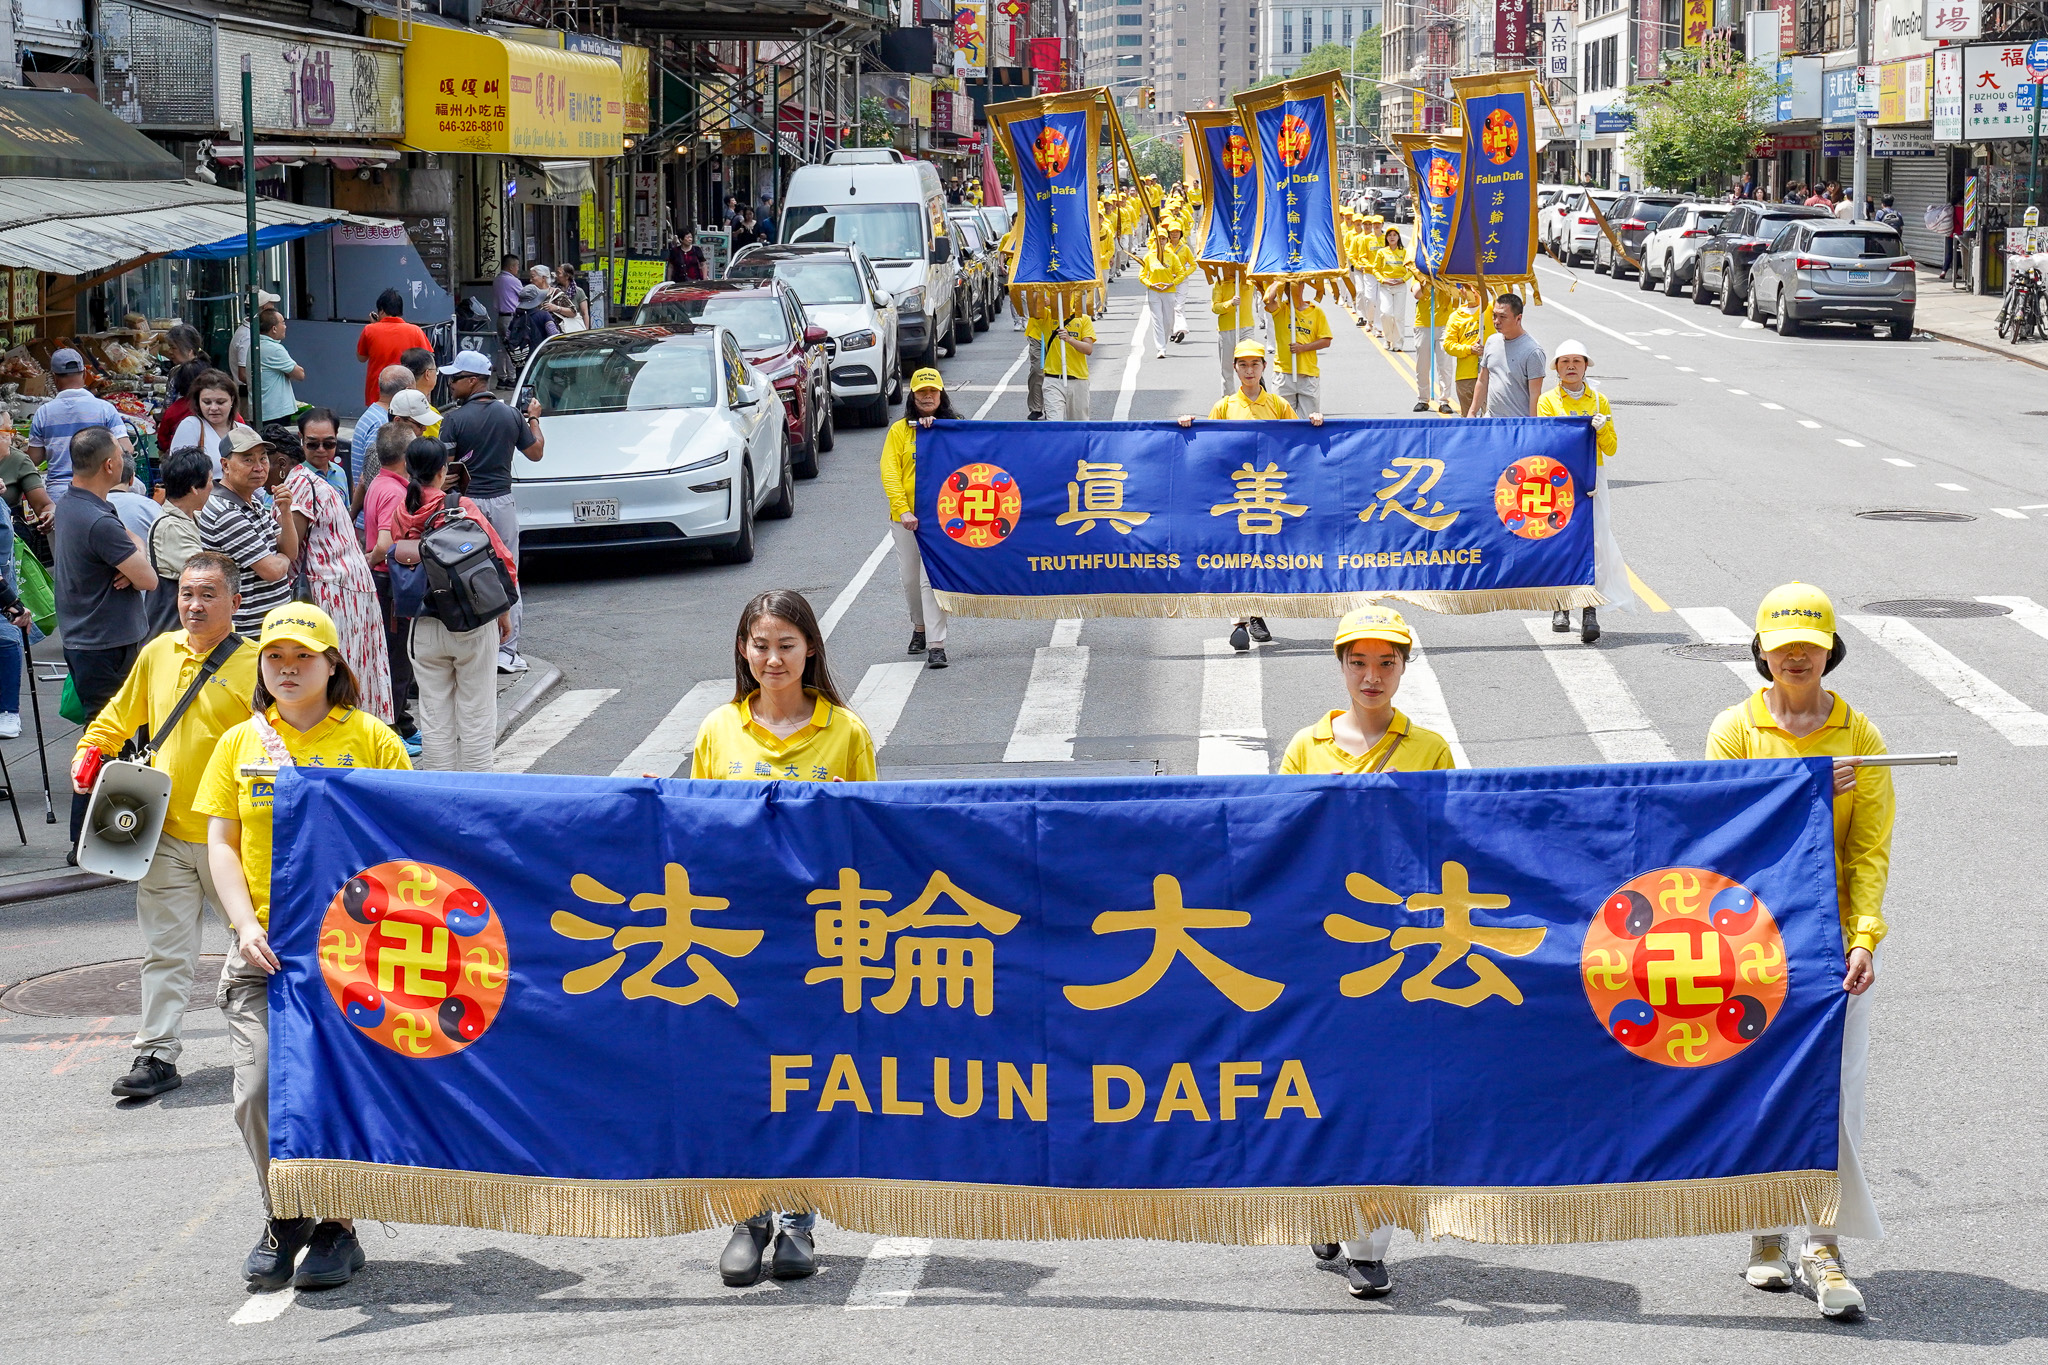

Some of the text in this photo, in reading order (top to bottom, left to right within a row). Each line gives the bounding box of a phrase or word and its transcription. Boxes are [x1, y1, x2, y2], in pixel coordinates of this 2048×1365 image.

[1892, 11, 1921, 41] MoneyGra
[1551, 15, 1567, 73] 大帝國
[1969, 93, 2005, 101] FUZHOU
[2018, 85, 2028, 95] M9
[2018, 97, 2033, 107] M22
[435, 103, 506, 118] 福州小吃店
[439, 120, 504, 132] 646-326-8810
[1824, 131, 1855, 142] 安順大
[1892, 133, 1934, 141] VNS Health
[1292, 172, 1319, 183] Dafa
[1476, 170, 1524, 184] Falun Dafa
[1051, 185, 1077, 195] Dafa
[1482, 190, 1506, 264] 法輪大法
[461, 335, 484, 352] 67
[1027, 548, 1482, 572] TRUTHFULNESS COMPASSION FORBEARANCE
[253, 753, 355, 767] 法大法
[728, 760, 829, 781] 法輪大法
[551, 861, 1547, 1017] 法輪大法
[769, 1053, 1323, 1123] FALUN DAFA
